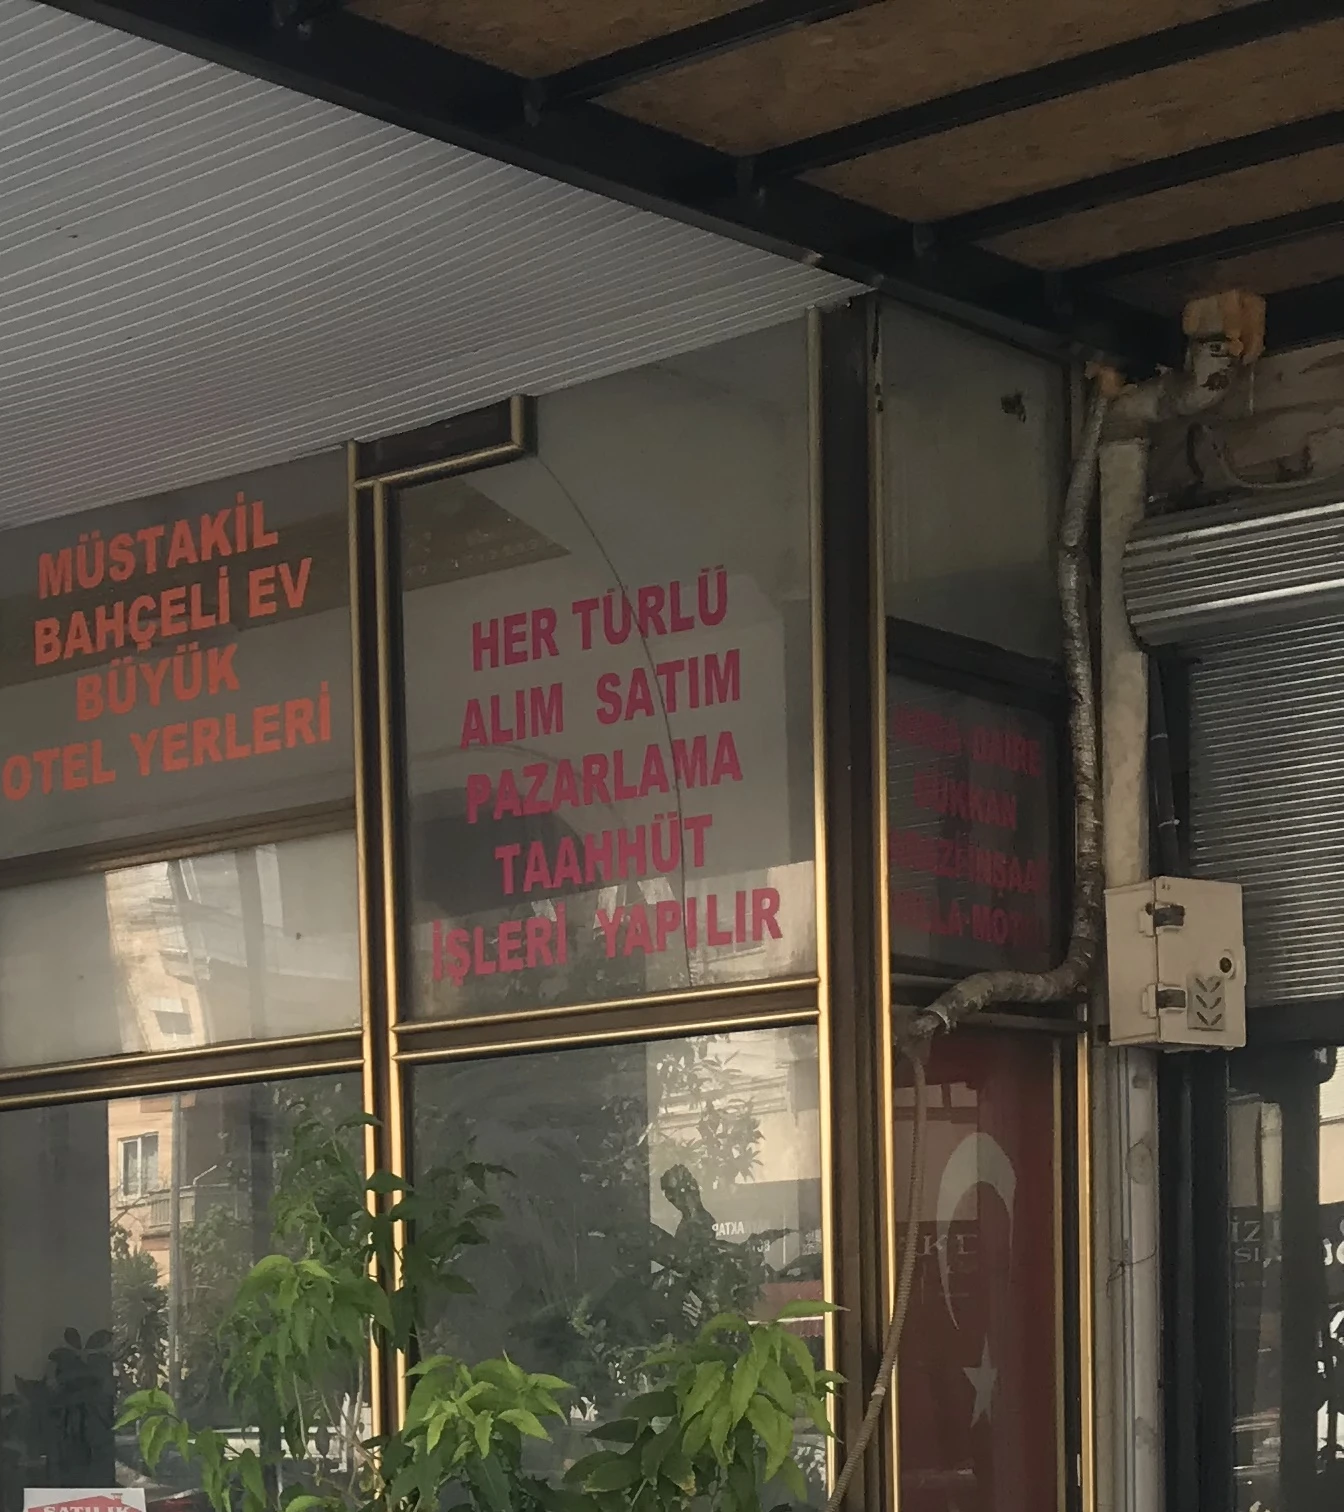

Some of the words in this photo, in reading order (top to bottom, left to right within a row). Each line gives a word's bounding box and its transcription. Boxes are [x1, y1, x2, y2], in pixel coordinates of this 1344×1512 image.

[38, 491, 279, 600] MÜSTAKİL
[33, 567, 231, 666] BAHÇELİ
[248, 558, 313, 617] EV
[471, 608, 557, 673] HER
[76, 643, 240, 722] BÜYÜK
[460, 682, 565, 750] ALIM
[594, 648, 743, 721] SATIM
[1, 743, 115, 801] OTEL
[129, 682, 333, 776] YERLERİ
[465, 730, 744, 825] PAZARLAMA
[495, 813, 712, 896] TAAHHÜT
[431, 913, 567, 987] İŞLERİ
[599, 886, 783, 959] YAPILIR
